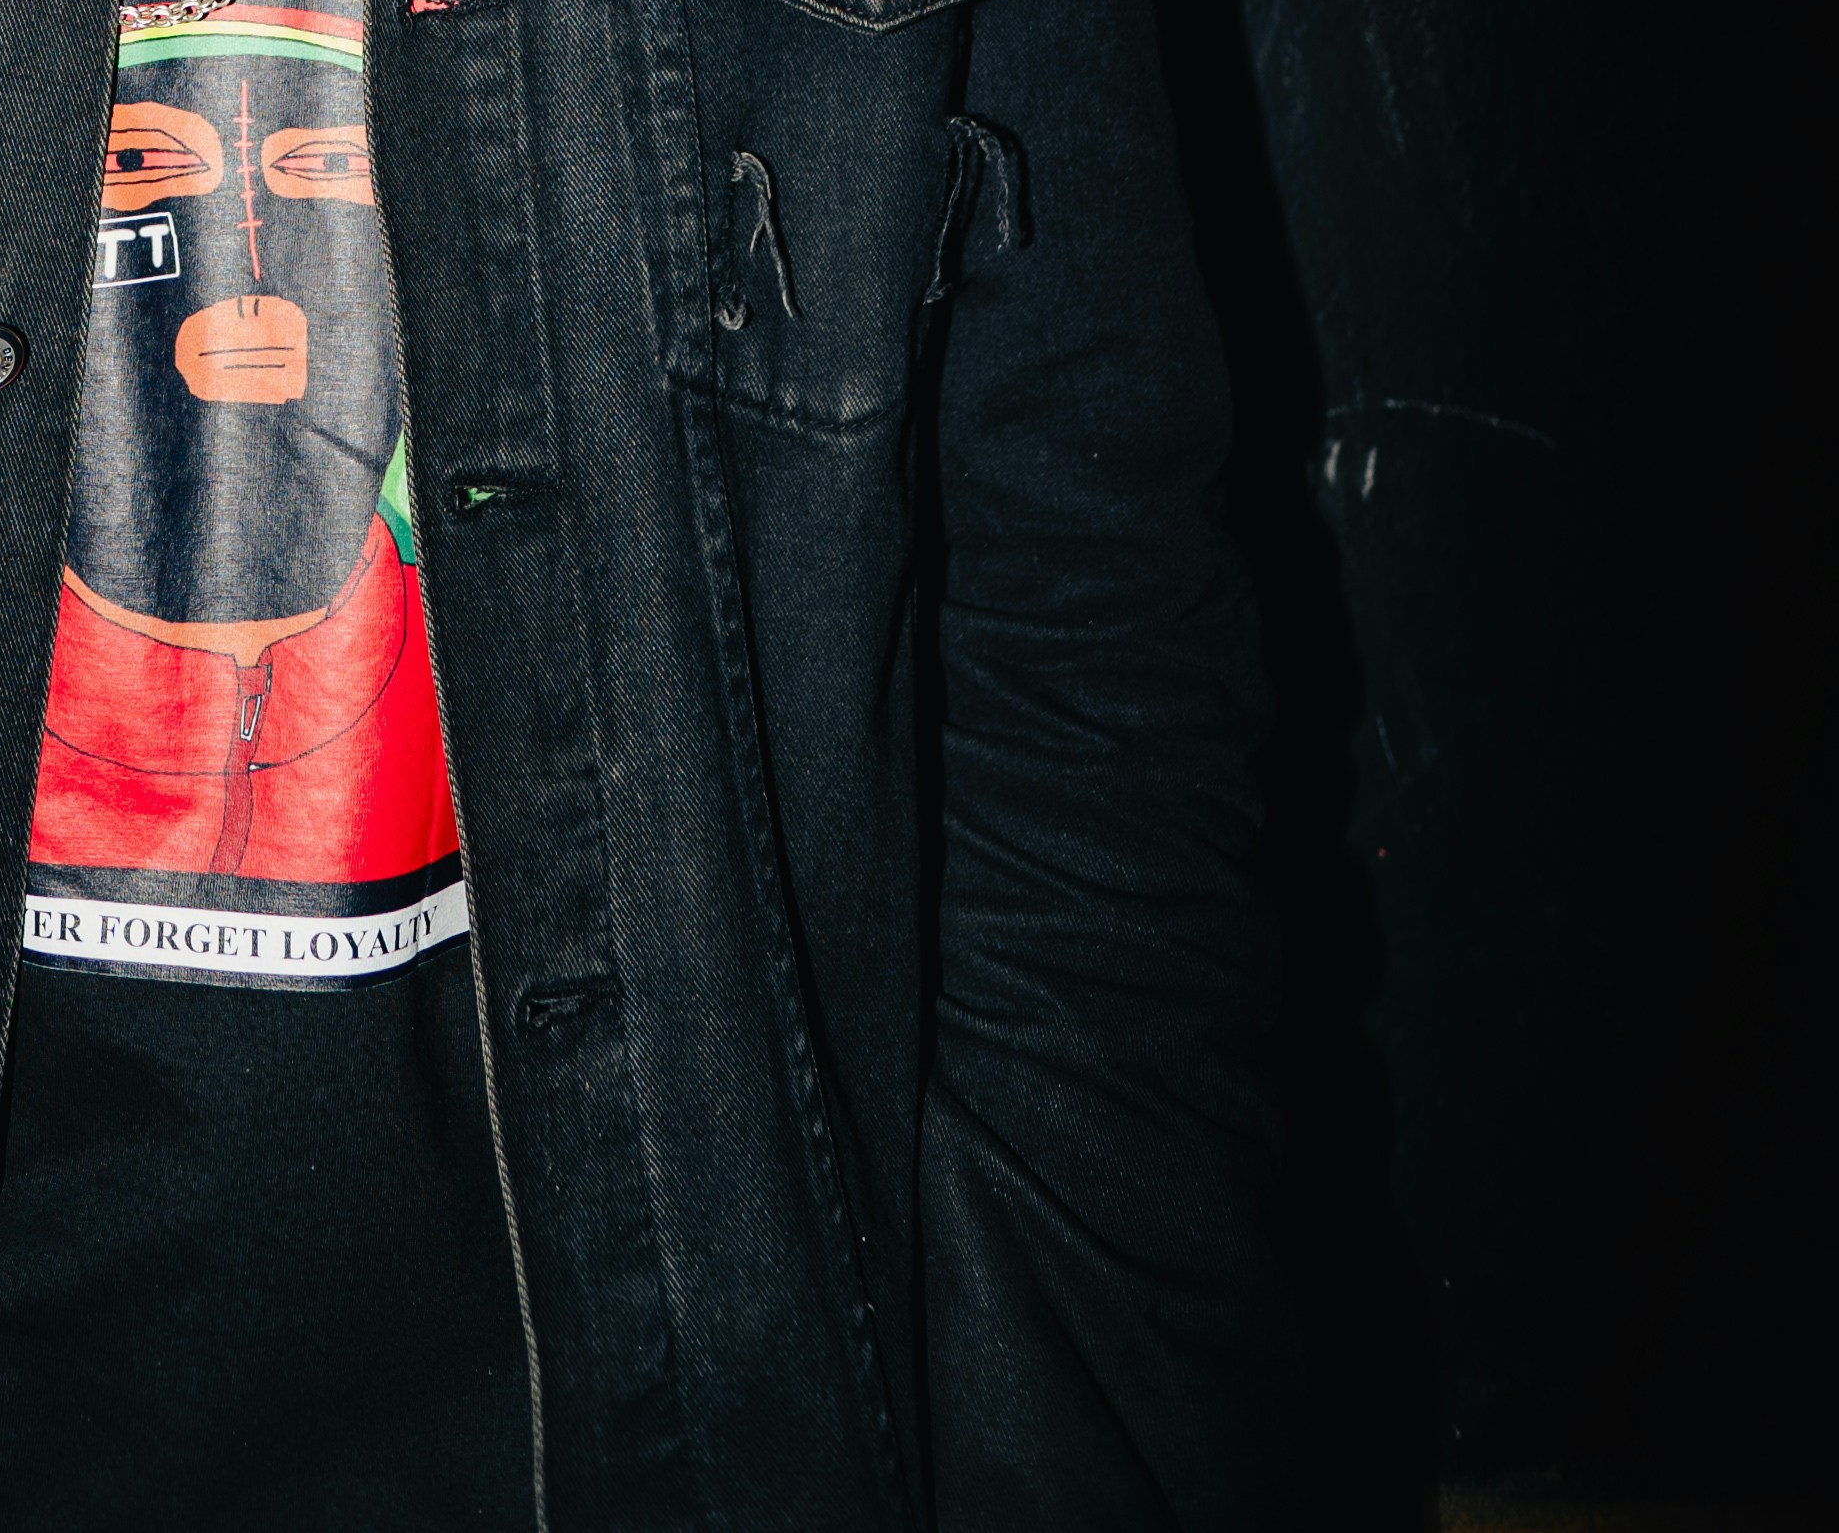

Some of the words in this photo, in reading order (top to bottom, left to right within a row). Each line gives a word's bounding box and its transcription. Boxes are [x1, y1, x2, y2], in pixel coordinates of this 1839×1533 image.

[24, 908, 82, 942] ER
[99, 913, 267, 958] FORGET
[281, 904, 439, 962] LOYALTY
